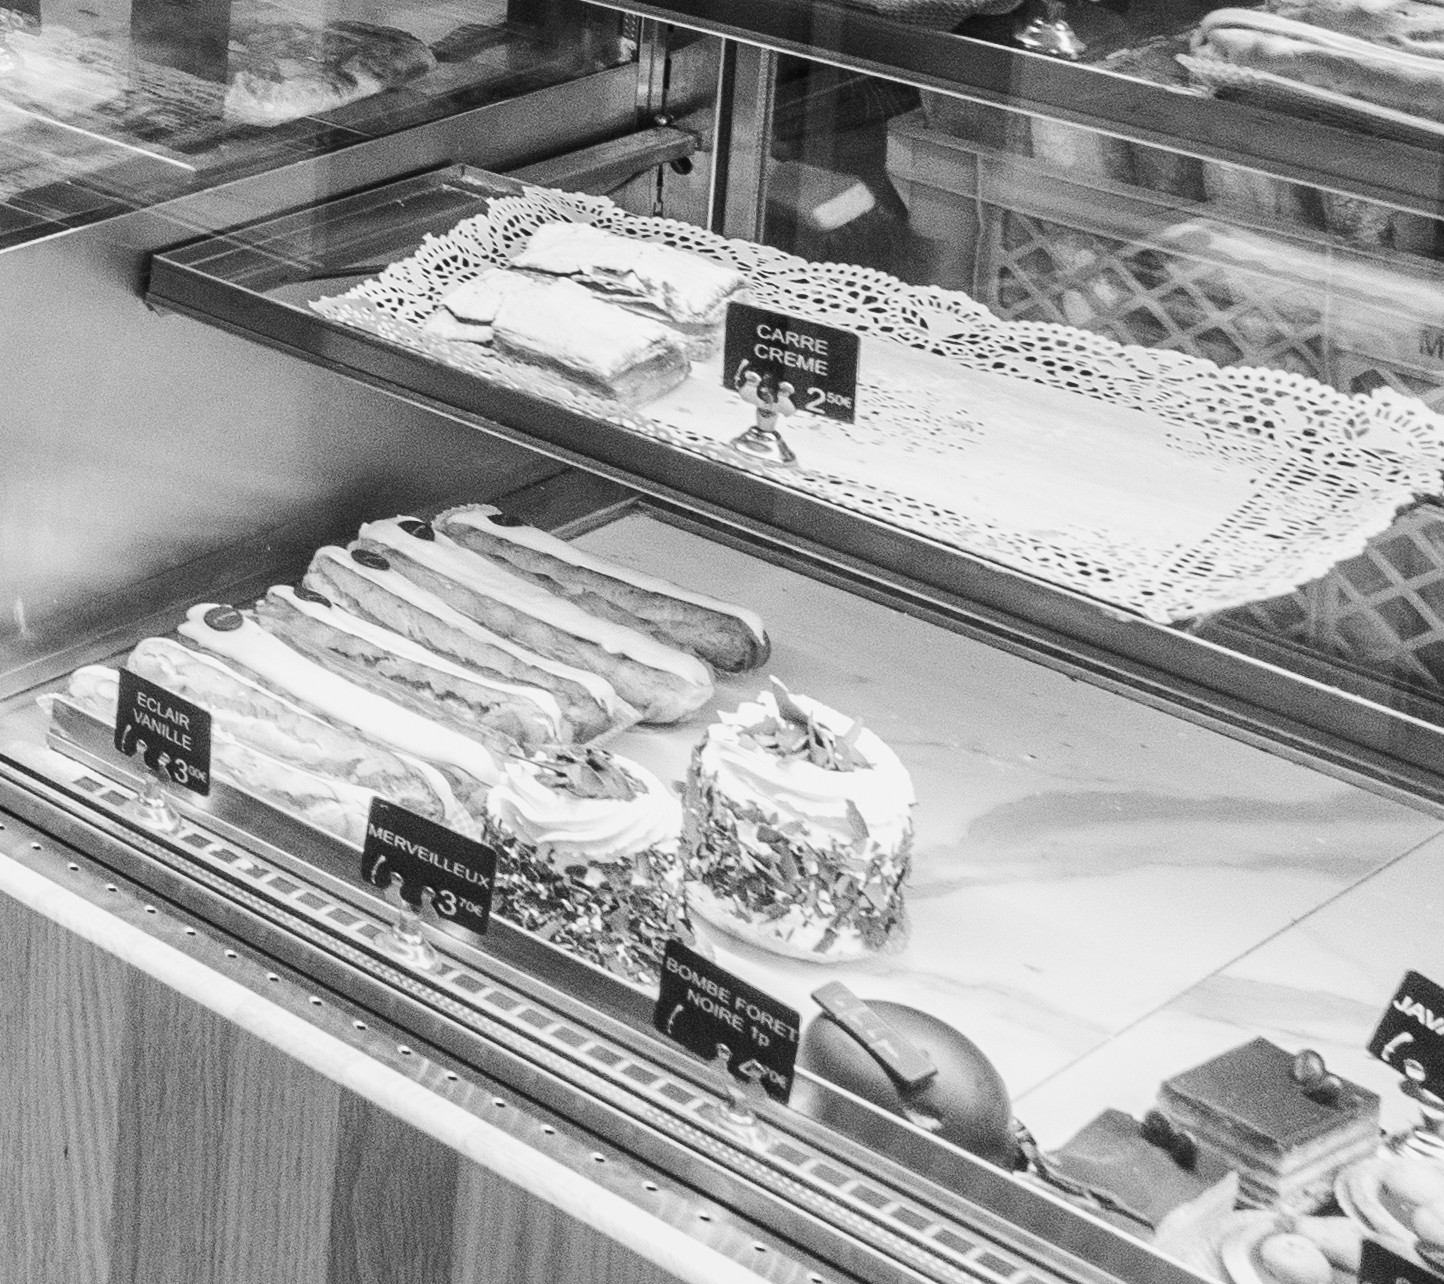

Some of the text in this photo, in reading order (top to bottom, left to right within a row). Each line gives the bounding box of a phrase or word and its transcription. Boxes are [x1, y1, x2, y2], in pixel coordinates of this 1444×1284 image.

[754, 343, 829, 377] CREME
[756, 324, 829, 356] CARRE
[132, 707, 193, 752] VANILLE
[136, 692, 191, 732] ECLAIR
[366, 824, 490, 890] MERVEILLEUX
[667, 958, 799, 1044] BOMBE FORET
[686, 988, 746, 1034] NOIRE
